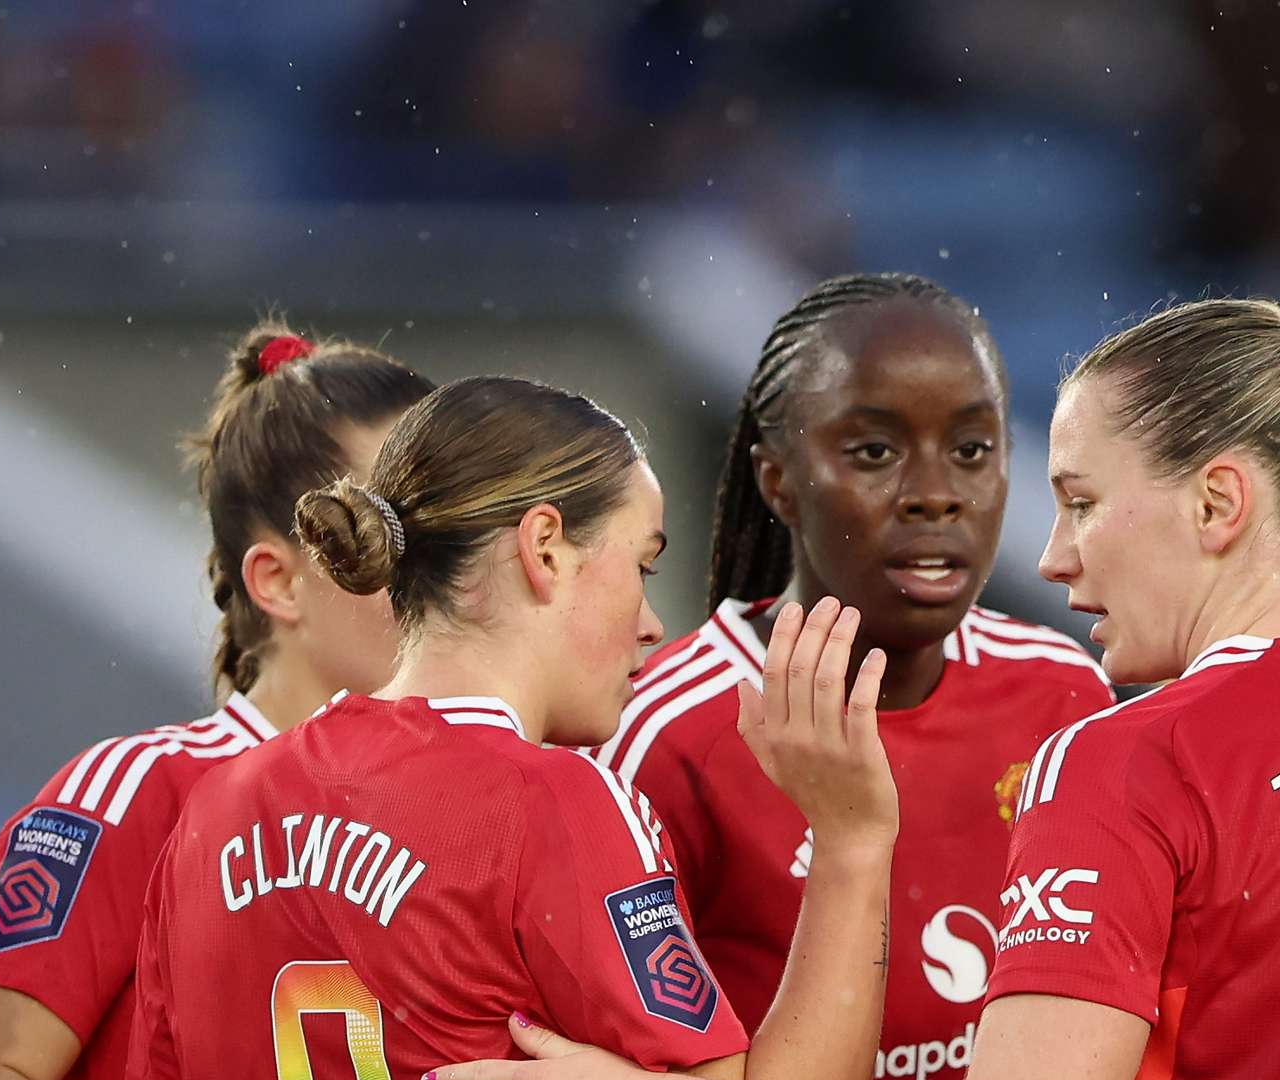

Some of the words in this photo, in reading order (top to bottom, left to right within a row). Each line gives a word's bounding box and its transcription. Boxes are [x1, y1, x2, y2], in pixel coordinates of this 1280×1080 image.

[18, 828, 83, 856] WOMEN'S
[33, 816, 89, 842] BARCLAYS
[37, 845, 78, 866] LEAGUE
[220, 813, 426, 929] CLINTON
[629, 921, 663, 940] SUPER
